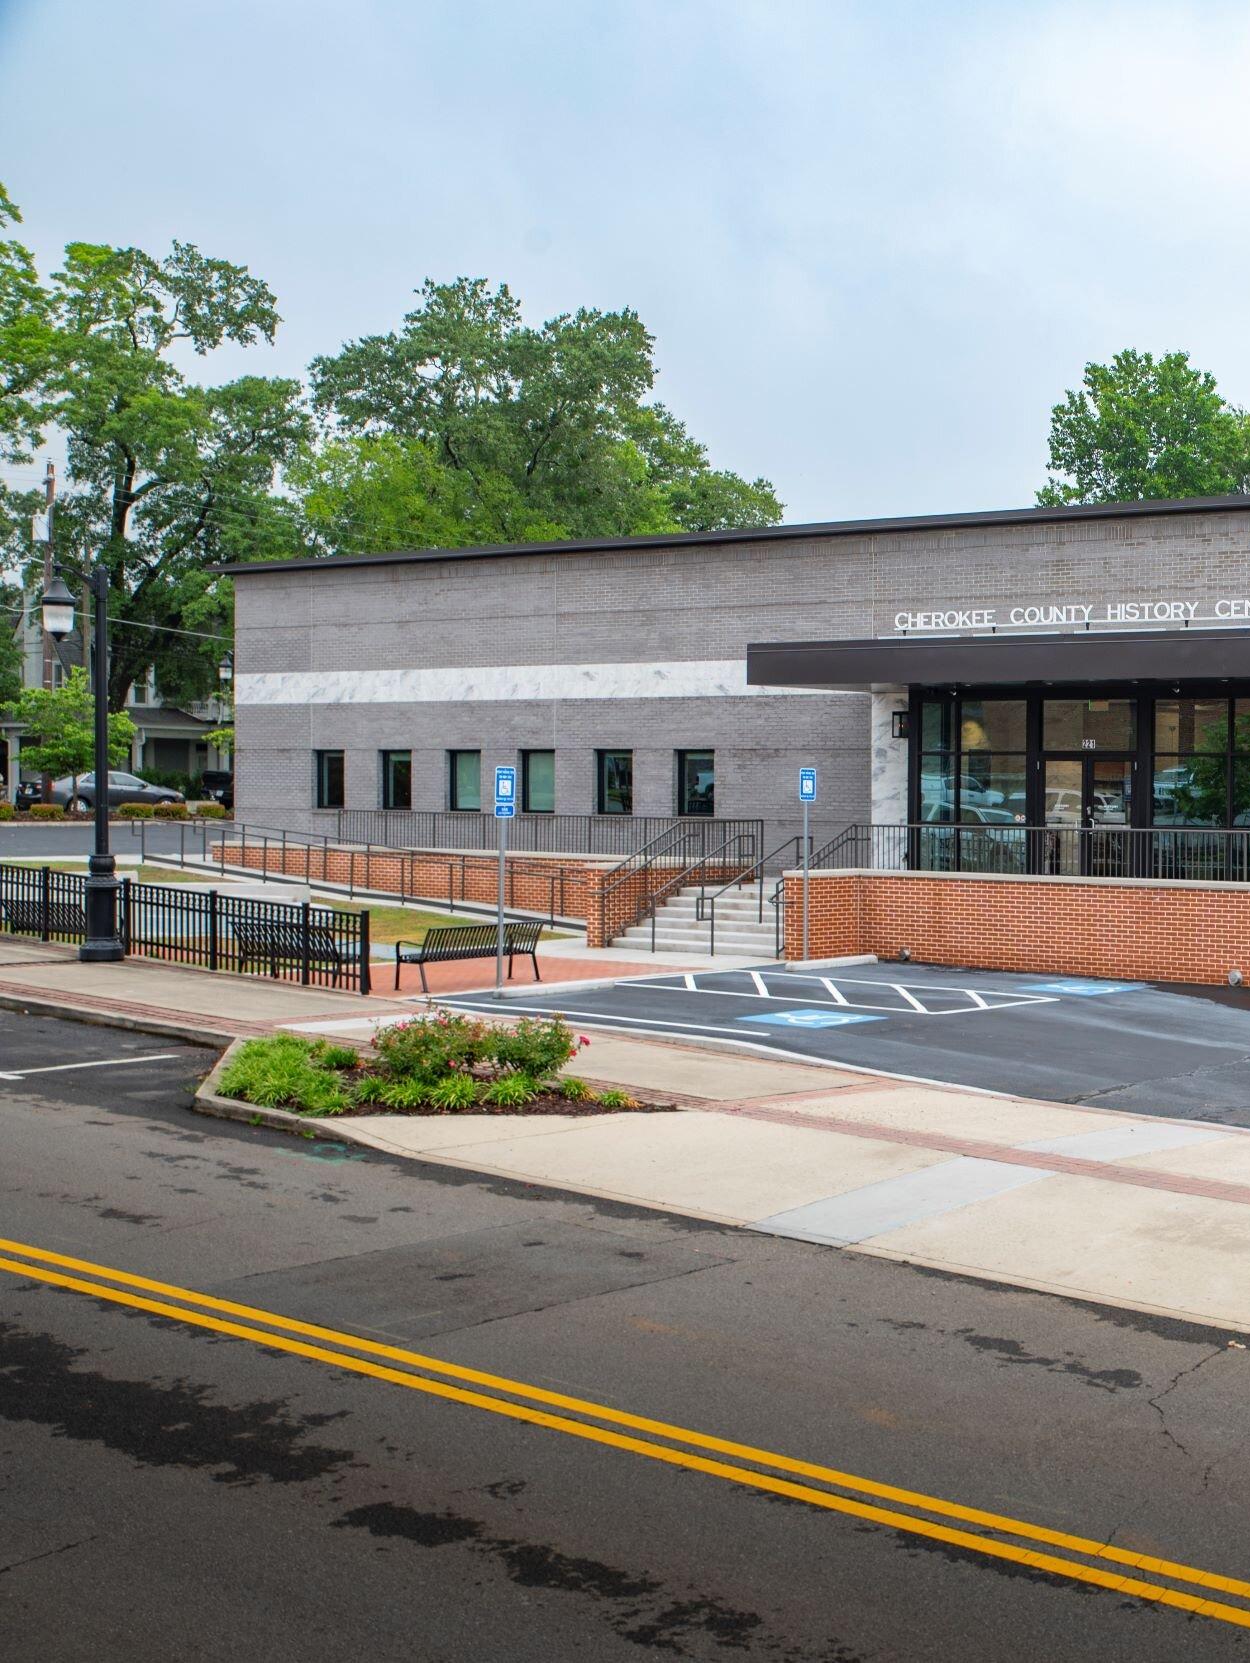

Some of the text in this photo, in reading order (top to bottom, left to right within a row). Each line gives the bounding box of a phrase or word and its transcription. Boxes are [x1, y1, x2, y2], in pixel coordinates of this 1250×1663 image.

[894, 609, 996, 629] CHEROKEE
[1010, 604, 1094, 625] COUNTY
[1107, 601, 1200, 621] HISTORY
